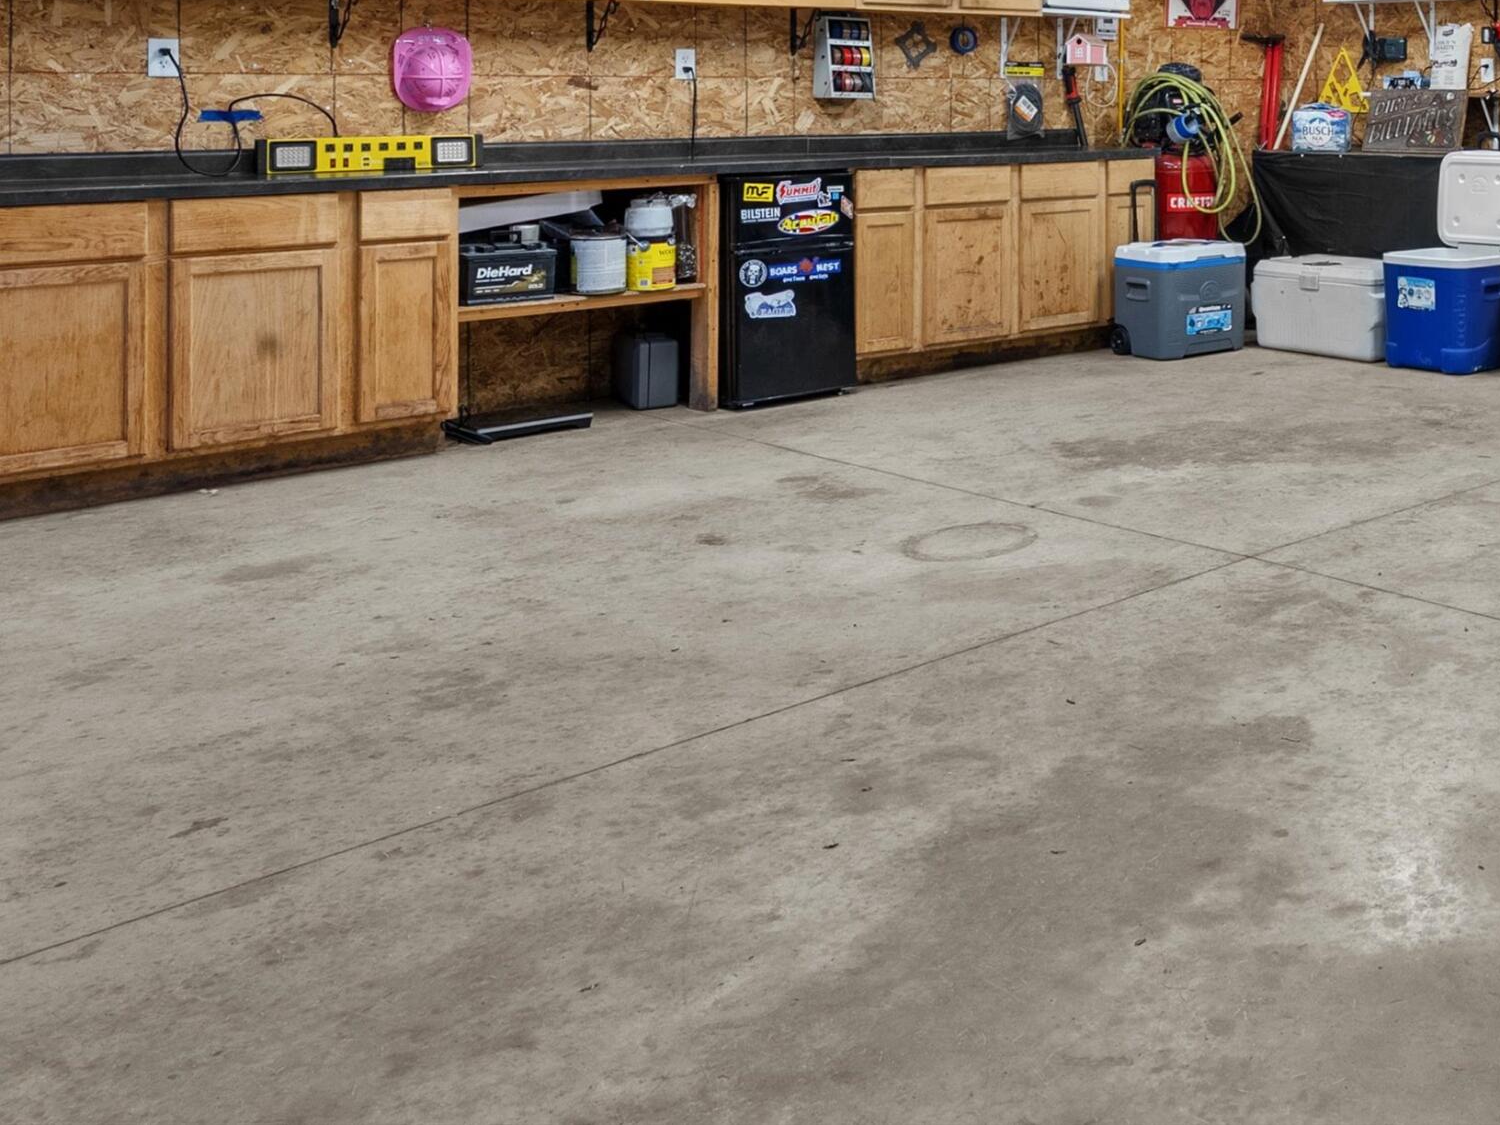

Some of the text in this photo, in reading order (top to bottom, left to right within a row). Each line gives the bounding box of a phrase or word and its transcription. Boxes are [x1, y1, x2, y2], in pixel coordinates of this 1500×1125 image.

[1302, 126, 1334, 136] BUSCH
[779, 182, 817, 198] SUMMIT
[741, 207, 780, 220] BILSTEIN
[476, 264, 533, 279] DieHard
